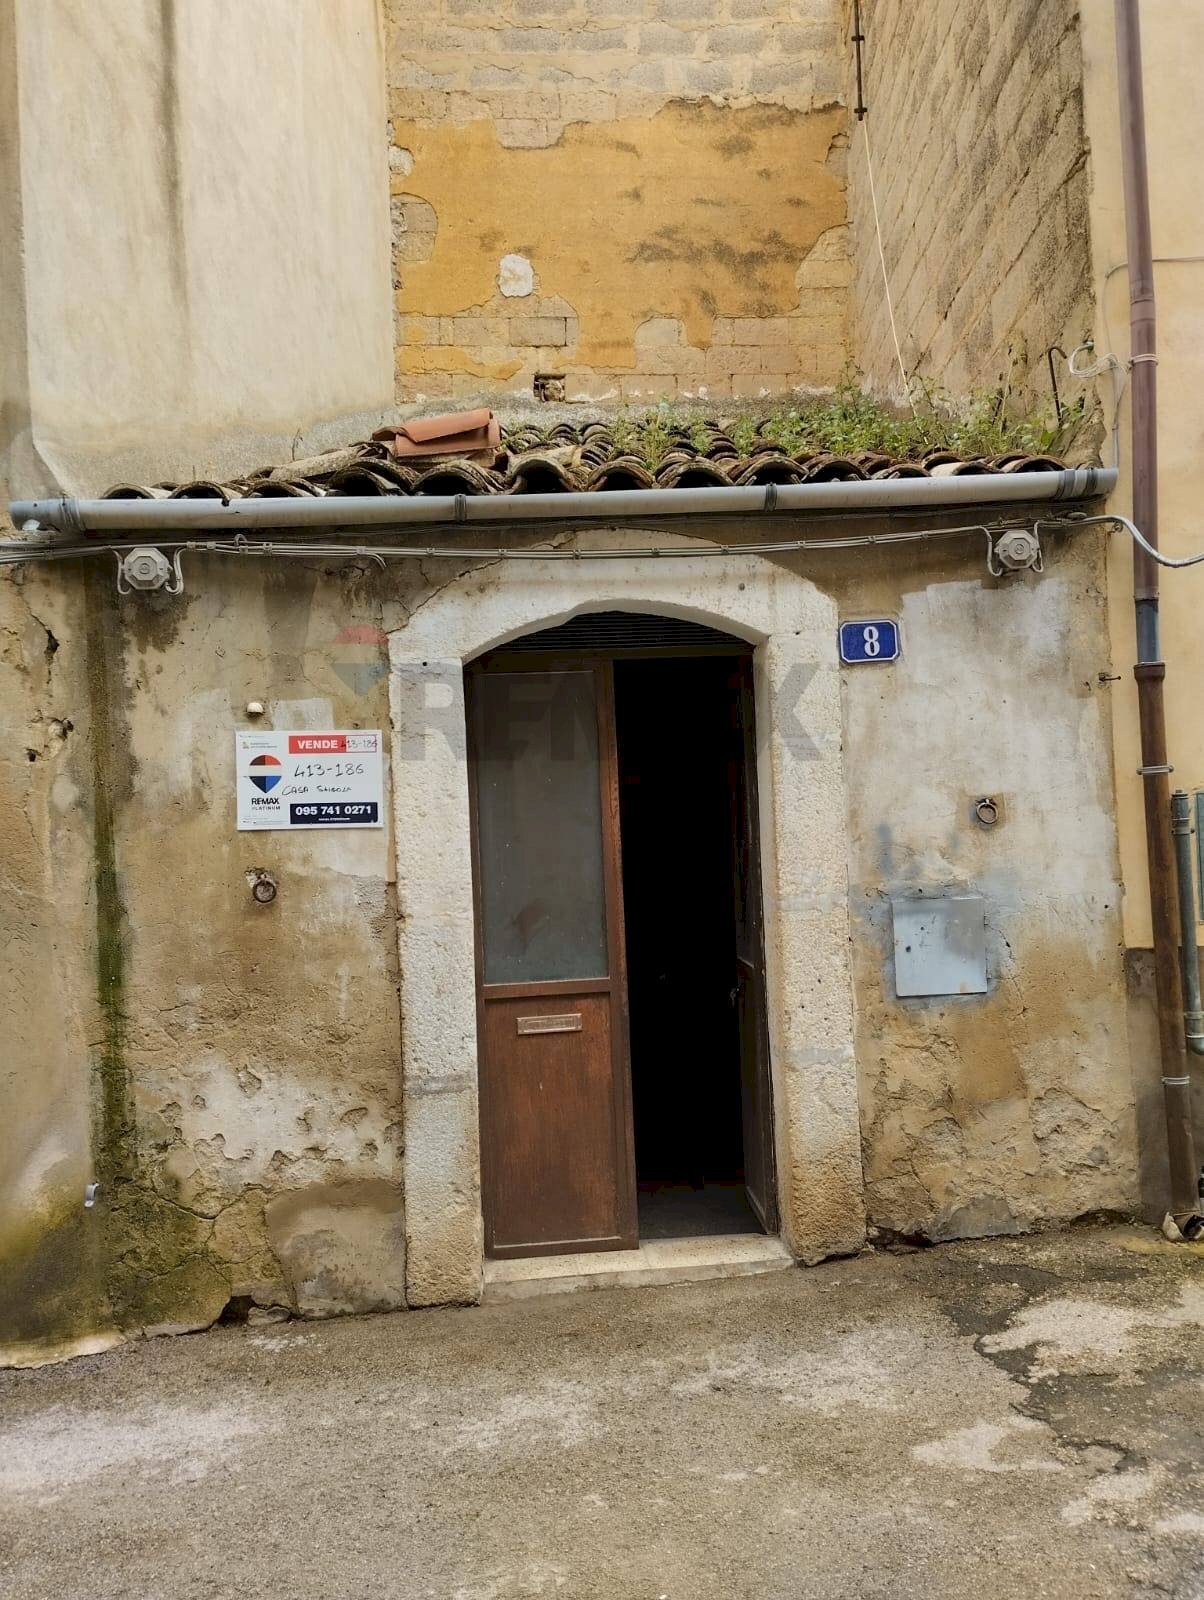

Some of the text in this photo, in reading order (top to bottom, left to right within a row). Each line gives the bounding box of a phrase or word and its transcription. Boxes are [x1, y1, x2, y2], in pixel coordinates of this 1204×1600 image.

[863, 626, 880, 656] 8
[296, 739, 338, 750] VENDE
[294, 763, 365, 778] 413-186
[281, 785, 309, 796] CASA
[251, 797, 280, 805] REMAX
[295, 805, 372, 816] 095 741 0271
